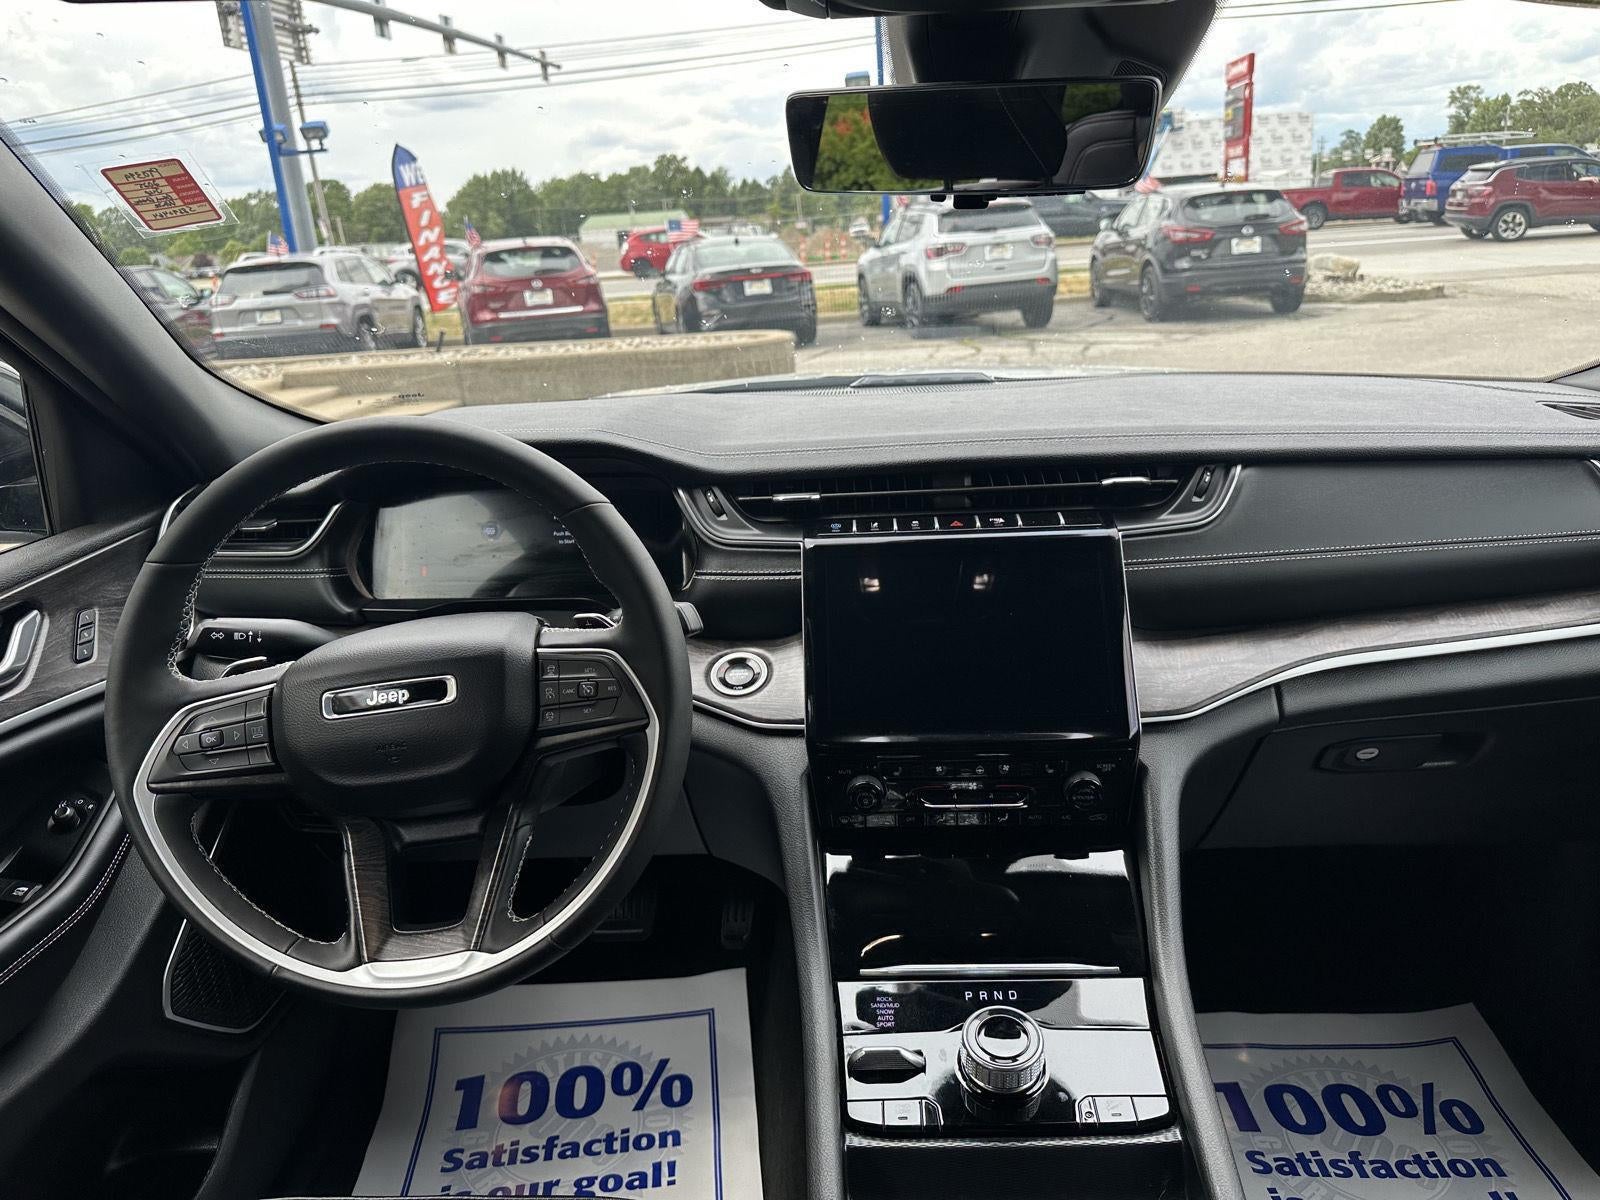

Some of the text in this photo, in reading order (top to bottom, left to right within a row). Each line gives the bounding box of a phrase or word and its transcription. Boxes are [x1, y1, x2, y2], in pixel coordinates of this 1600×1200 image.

[410, 191, 459, 305] FINANCE
[366, 689, 410, 706] Jeep
[205, 736, 217, 744] OK
[455, 1058, 693, 1131] 100%
[1214, 1081, 1485, 1137] 100%
[440, 1128, 682, 1173] Satisfaction
[1245, 1149, 1509, 1180] Satisfaction
